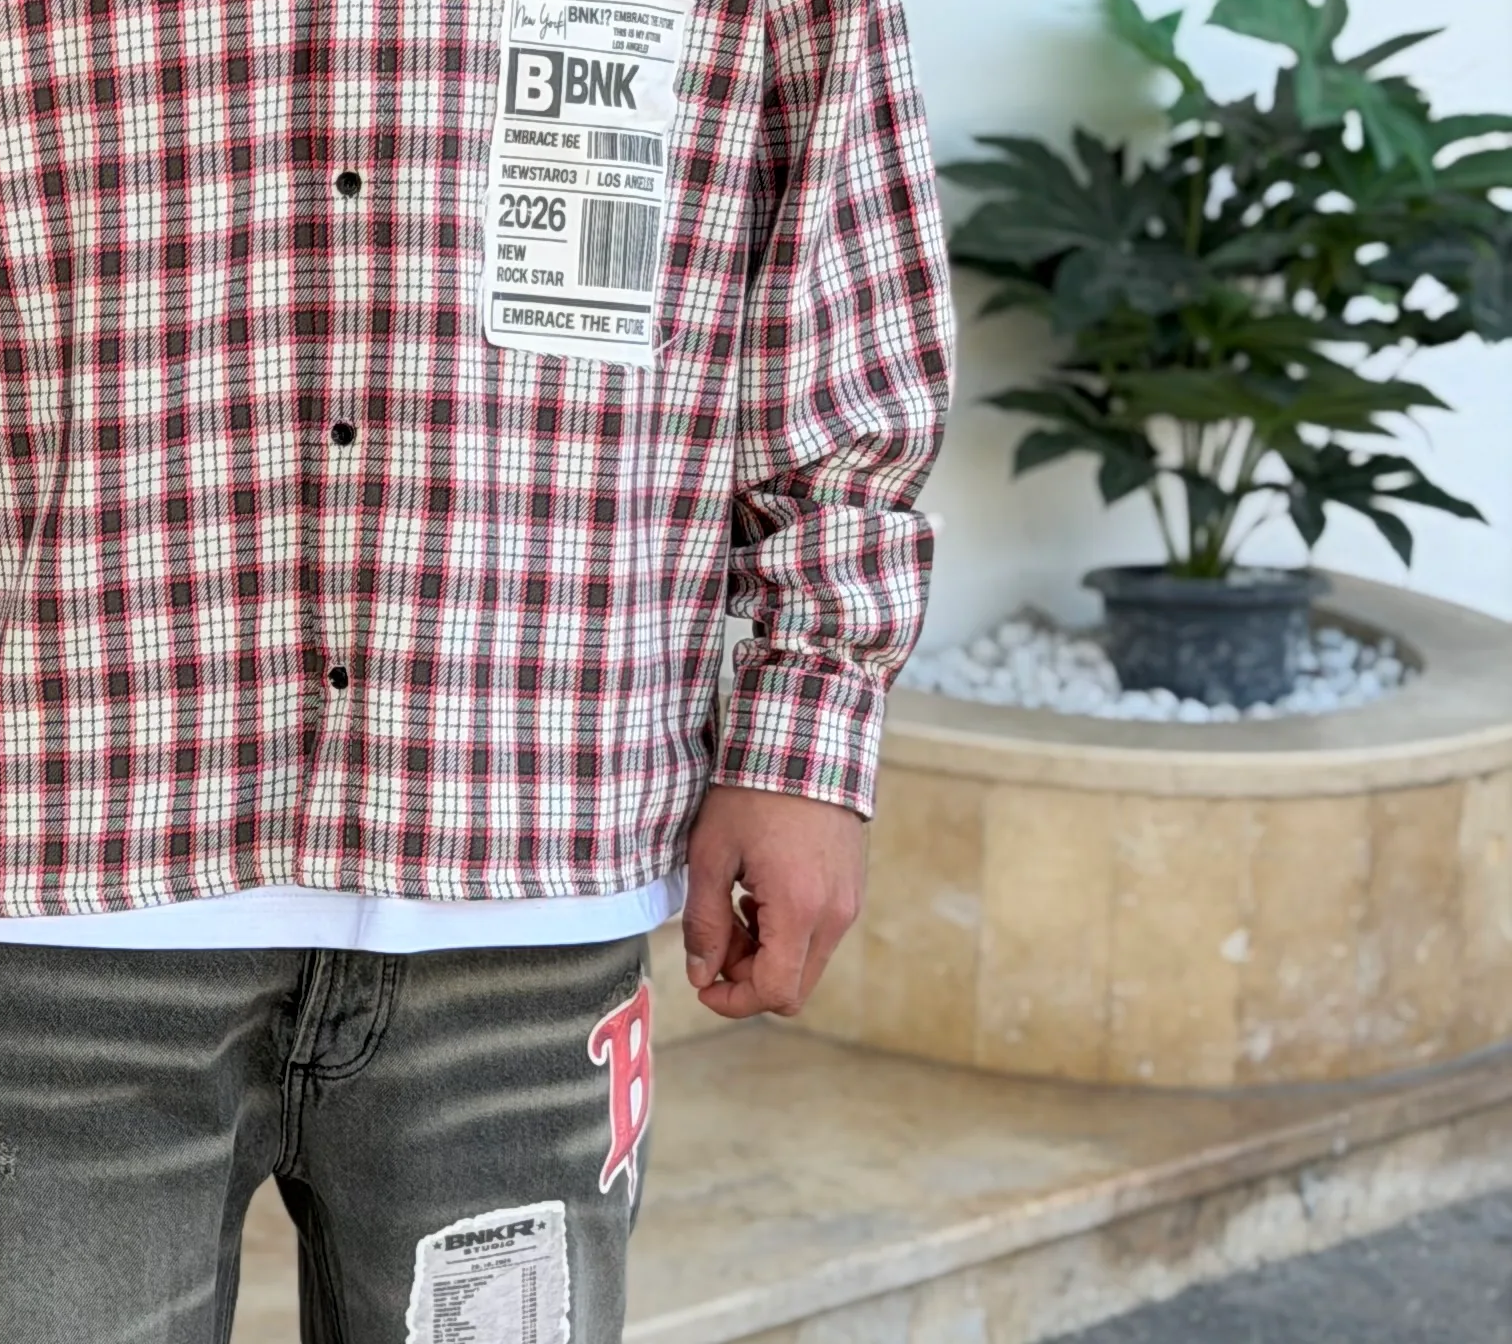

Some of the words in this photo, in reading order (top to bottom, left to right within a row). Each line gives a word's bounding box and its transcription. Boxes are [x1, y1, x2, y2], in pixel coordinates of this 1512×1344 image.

[568, 6, 612, 26] BNK!?
[565, 56, 639, 110] BNK
[504, 128, 559, 148] EMBRACE
[597, 171, 621, 188] LOS
[498, 193, 566, 232] 2026
[497, 243, 526, 261] NEW
[496, 266, 528, 284] ROCK
[531, 269, 564, 287] STAR
[502, 307, 575, 330] EMBRACE
[580, 313, 611, 332] THE
[444, 1218, 535, 1252] BNKR
[463, 1240, 515, 1255] STUDIO
